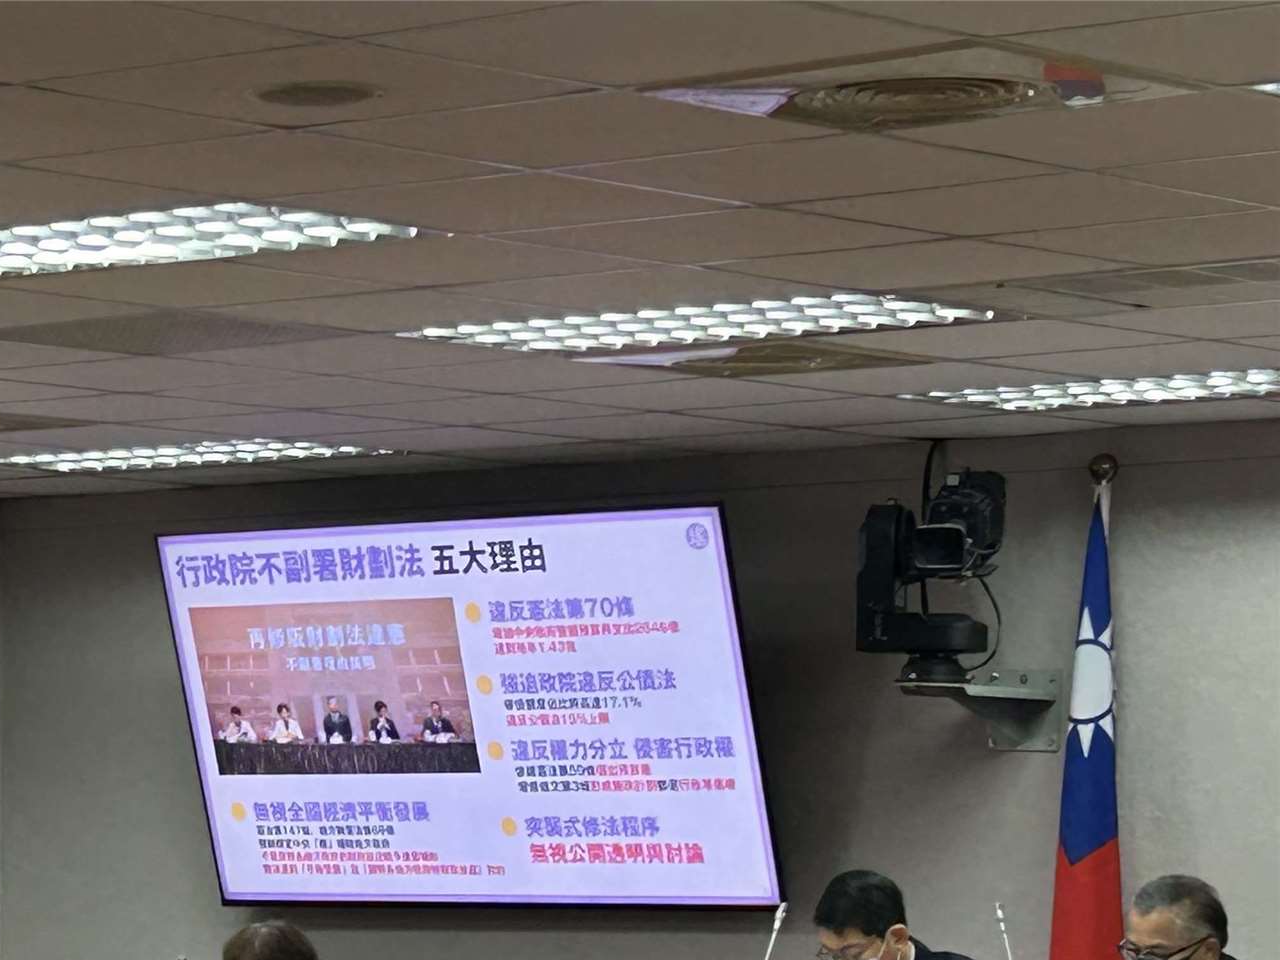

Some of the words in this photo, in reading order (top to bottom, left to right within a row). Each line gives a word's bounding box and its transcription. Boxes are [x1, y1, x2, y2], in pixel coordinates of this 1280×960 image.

[175, 544, 424, 588] 行政院不副署財劃法
[431, 538, 546, 576] 五大理由
[510, 739, 628, 761] 違反權力分立
[524, 815, 660, 838] 突襲式修法程序
